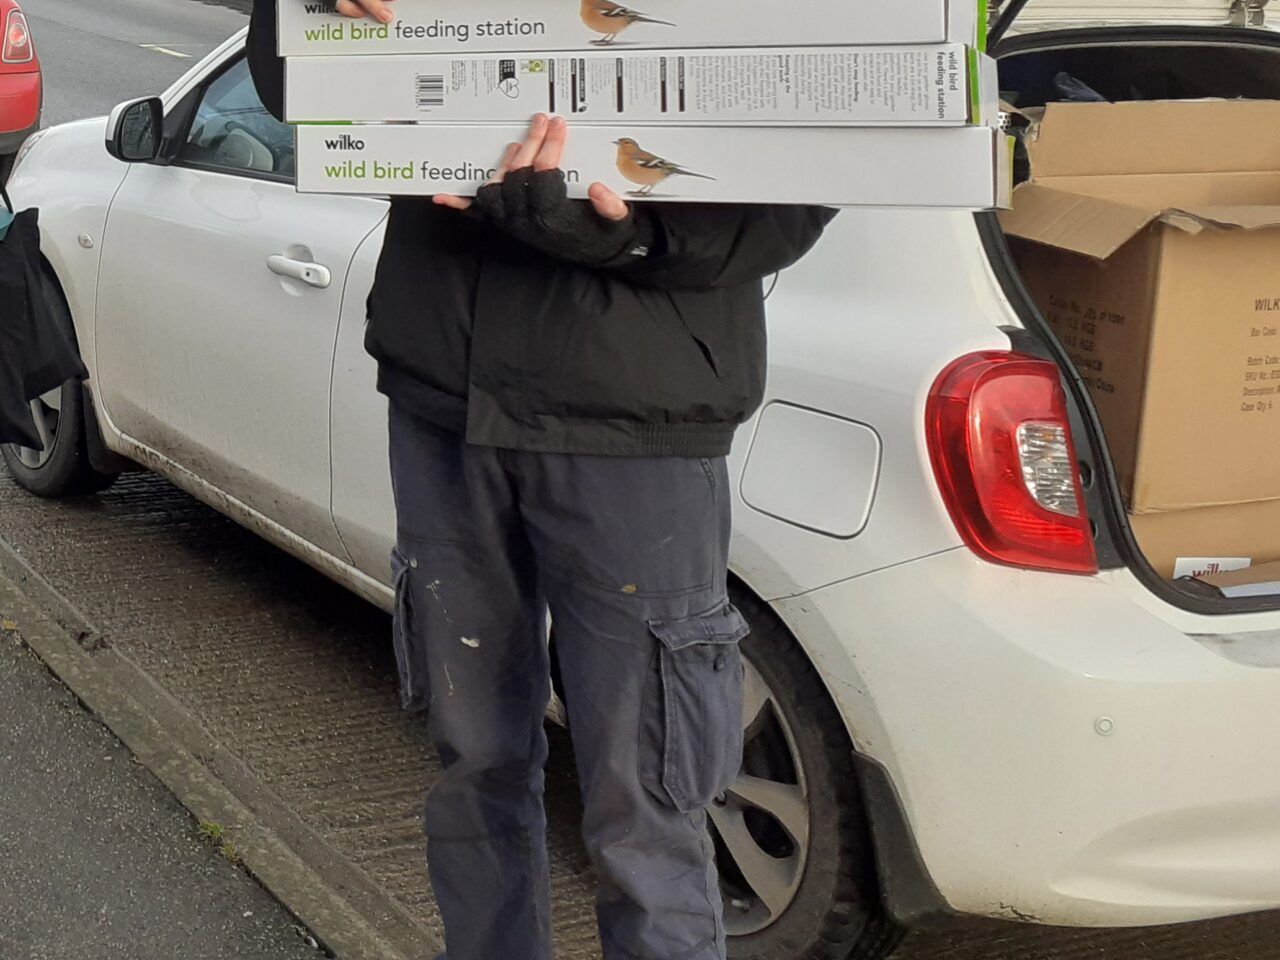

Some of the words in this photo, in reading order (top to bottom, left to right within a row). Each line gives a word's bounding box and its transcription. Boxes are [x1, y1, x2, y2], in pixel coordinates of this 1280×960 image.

[304, 3, 340, 15] wil
[304, 22, 344, 42] wild
[350, 21, 389, 41] bird
[394, 19, 470, 42] feeding
[475, 17, 546, 37] station
[935, 51, 947, 86] feeding
[948, 51, 958, 70] wild
[948, 73, 958, 91] bird
[937, 88, 947, 119] station
[324, 133, 365, 151] wilko
[324, 160, 367, 180] wild
[373, 161, 414, 180] bird
